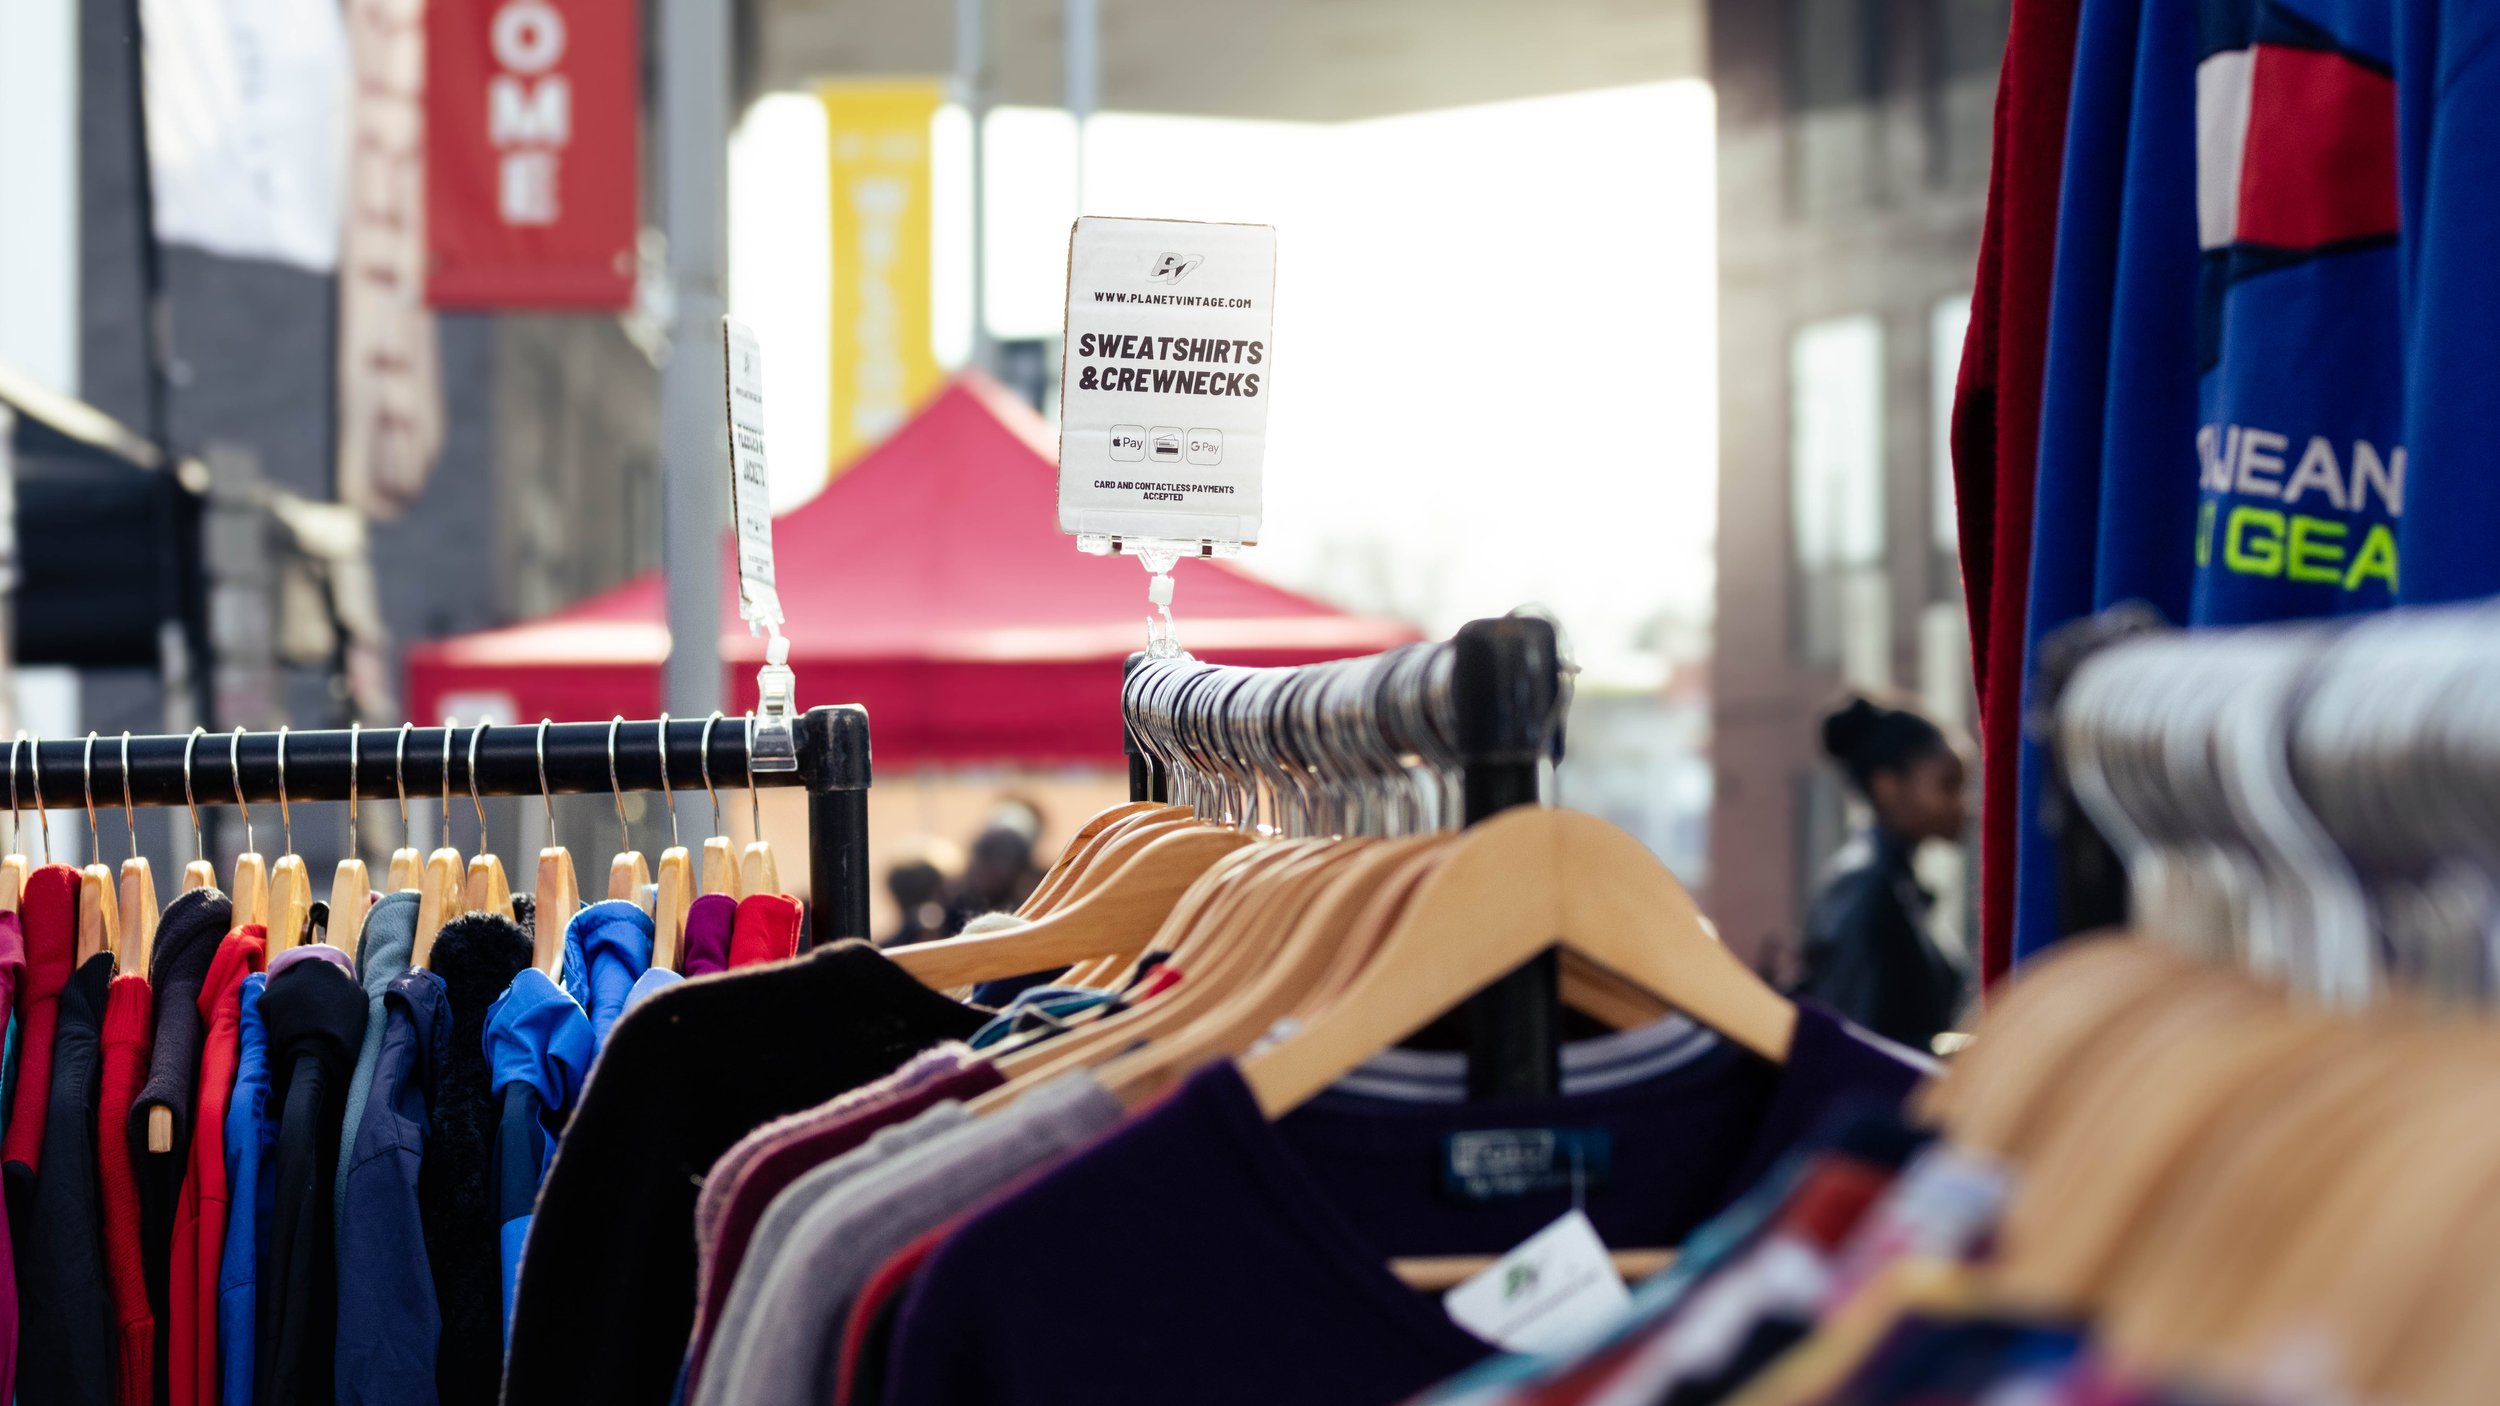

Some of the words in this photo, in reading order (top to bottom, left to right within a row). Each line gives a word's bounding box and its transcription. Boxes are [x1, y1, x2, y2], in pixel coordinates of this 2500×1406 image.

[1094, 291, 1252, 309] WWW.PLANETVINTAGE.COM
[1078, 332, 1264, 365] SWEATSHIRTS
[1078, 365, 1261, 398] &CREWNECKS
[1122, 436, 1144, 450] Pay
[1202, 441, 1220, 455] Pay
[1094, 480, 1116, 490] CARD
[1117, 481, 1134, 490] AND
[1134, 481, 1191, 493] CONTACTLESS
[1191, 484, 1235, 495] PAYMENTS
[1143, 491, 1184, 502] ACCEPTED
